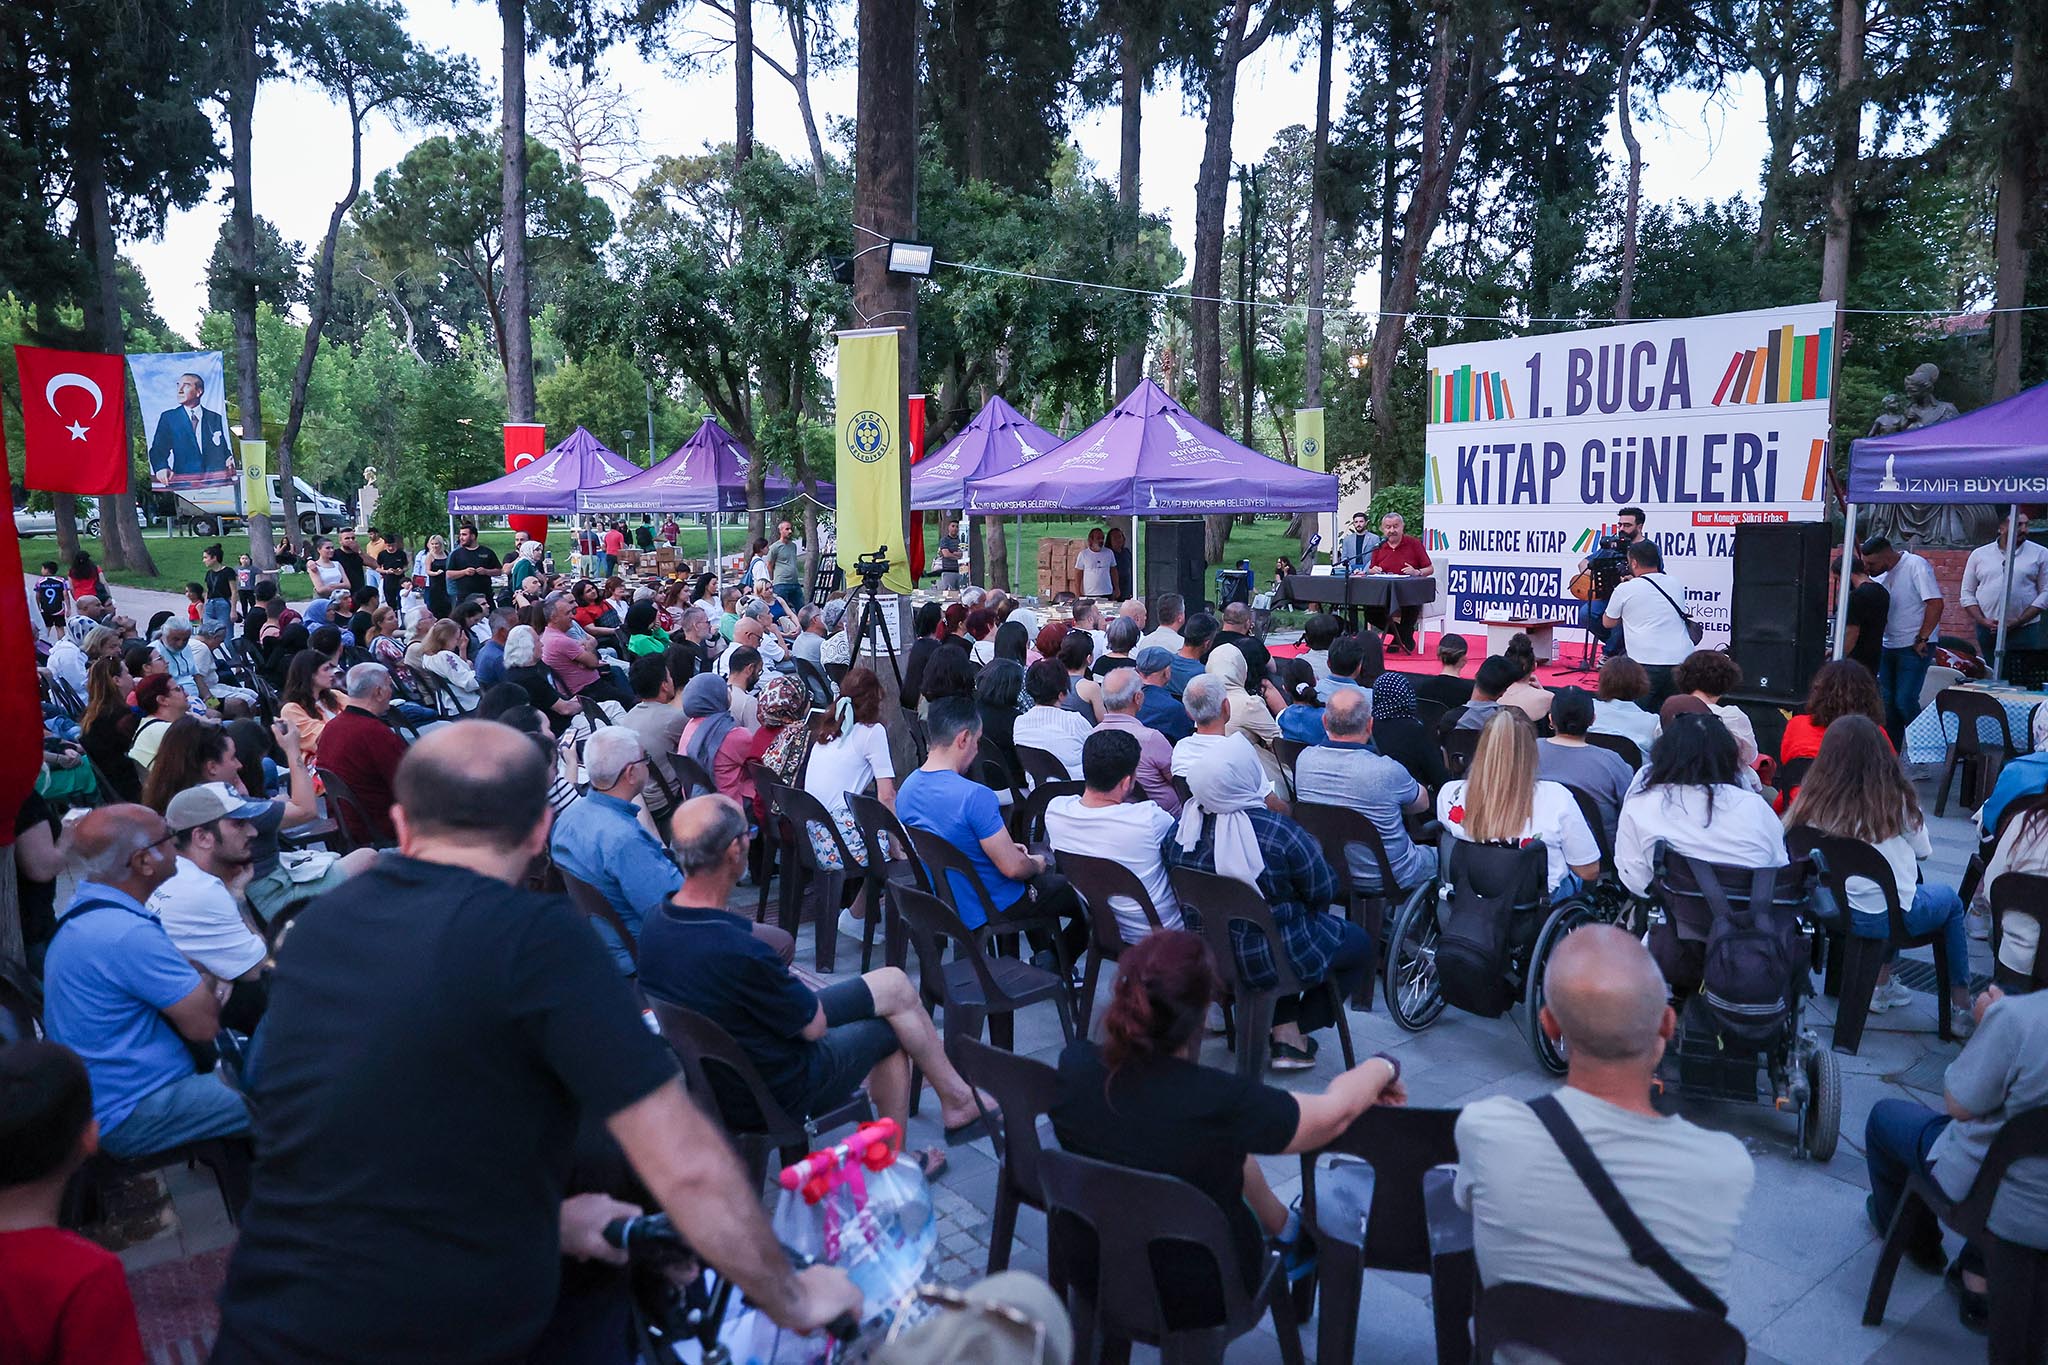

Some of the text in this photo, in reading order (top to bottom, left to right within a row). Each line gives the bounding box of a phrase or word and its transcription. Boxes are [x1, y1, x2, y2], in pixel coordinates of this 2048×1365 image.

[1525, 337, 1692, 419] 1. BUCA
[1963, 475, 2048, 494] BÜYÜKŞ
[1697, 512, 1713, 523] Onur
[1449, 569, 1559, 598] 25 MAYIS 2025
[45, 588, 56, 605] 9
[1684, 586, 1721, 601] imar
[1541, 603, 1579, 625] PARKI
